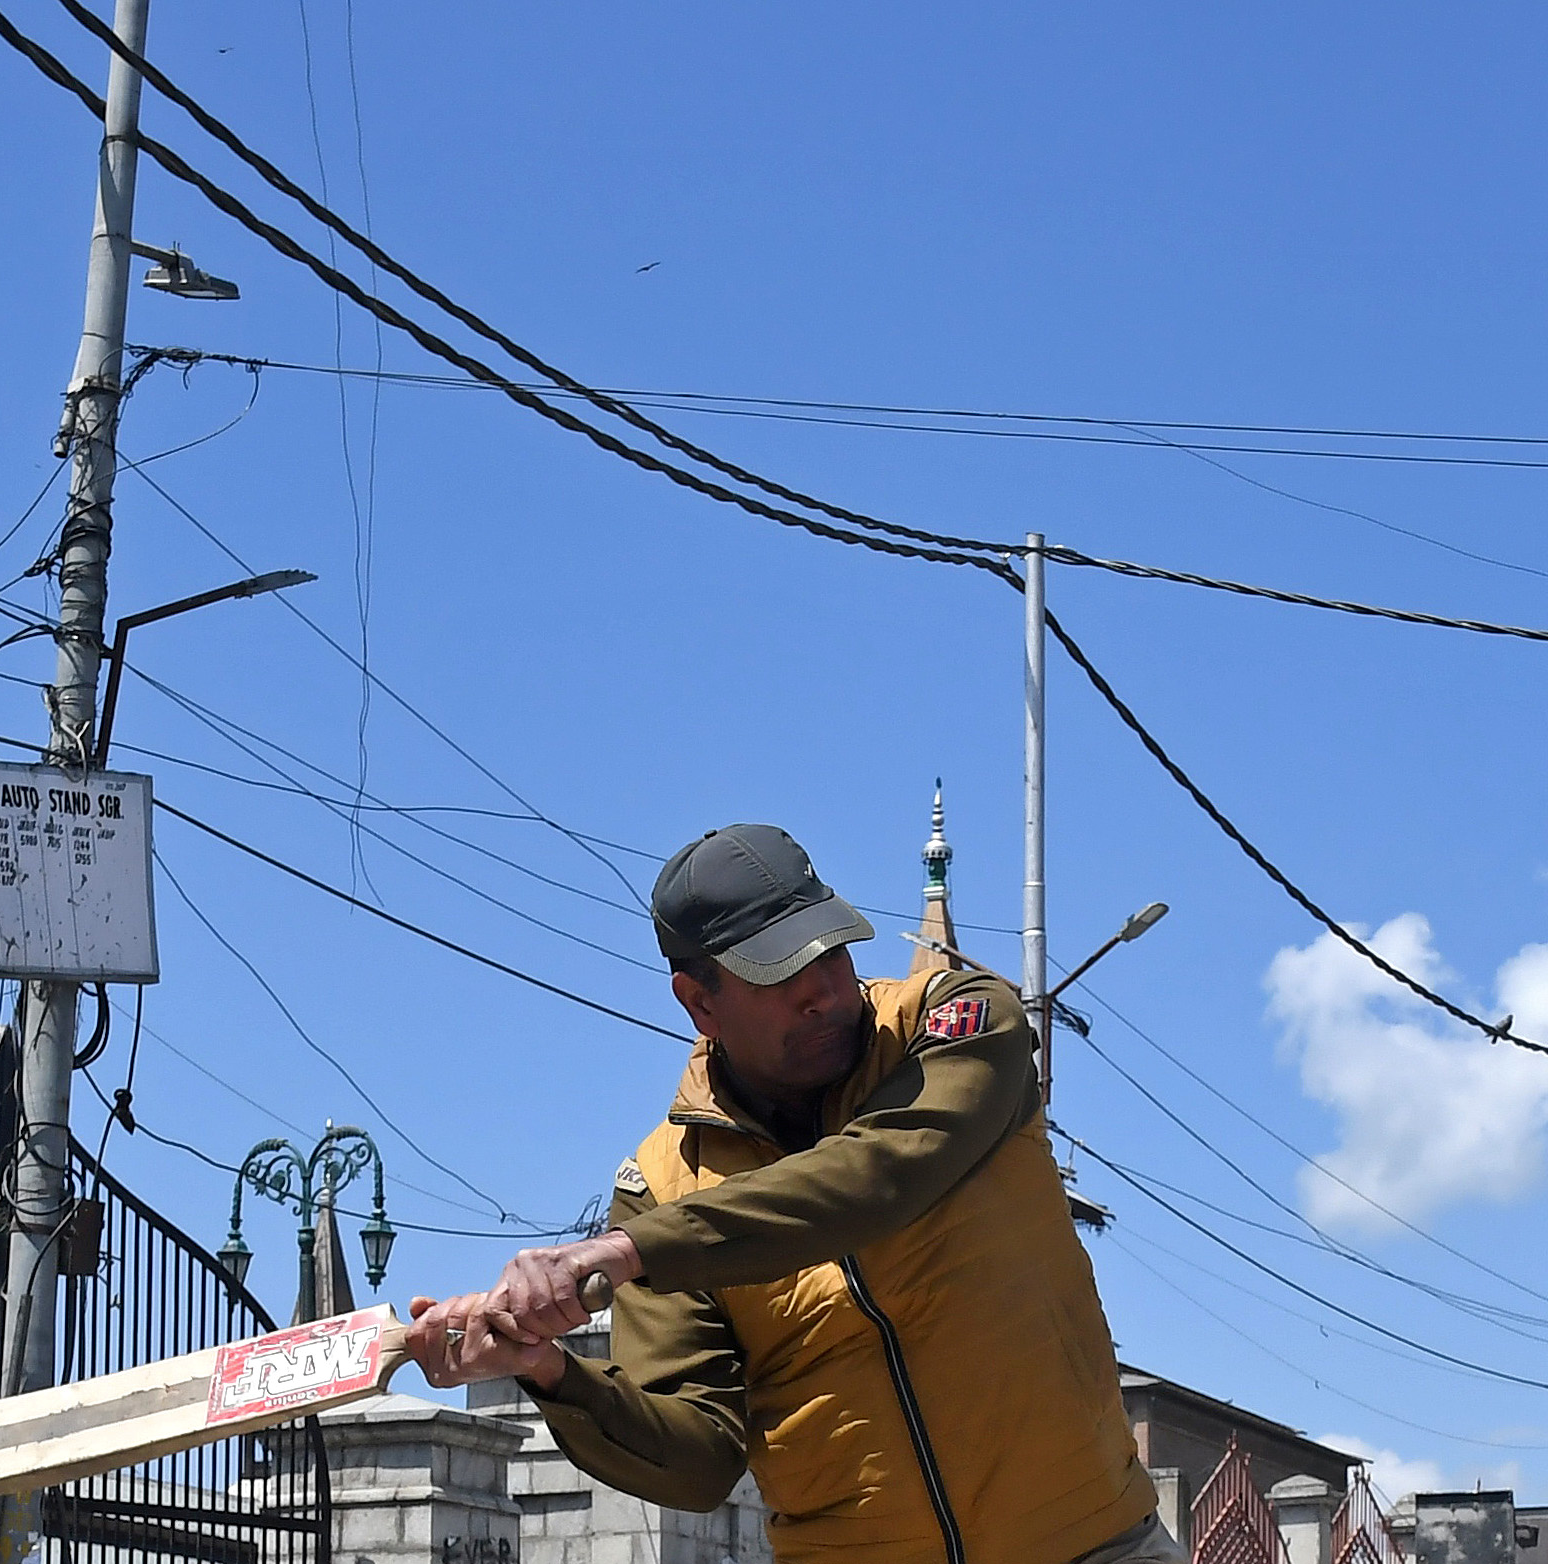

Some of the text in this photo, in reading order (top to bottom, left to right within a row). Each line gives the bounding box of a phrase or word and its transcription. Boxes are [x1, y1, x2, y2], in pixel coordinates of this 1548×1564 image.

[2, 784, 40, 810] AUTO
[49, 788, 90, 815] STAND
[98, 793, 124, 819] SGR.
[223, 1324, 380, 1408] MRF
